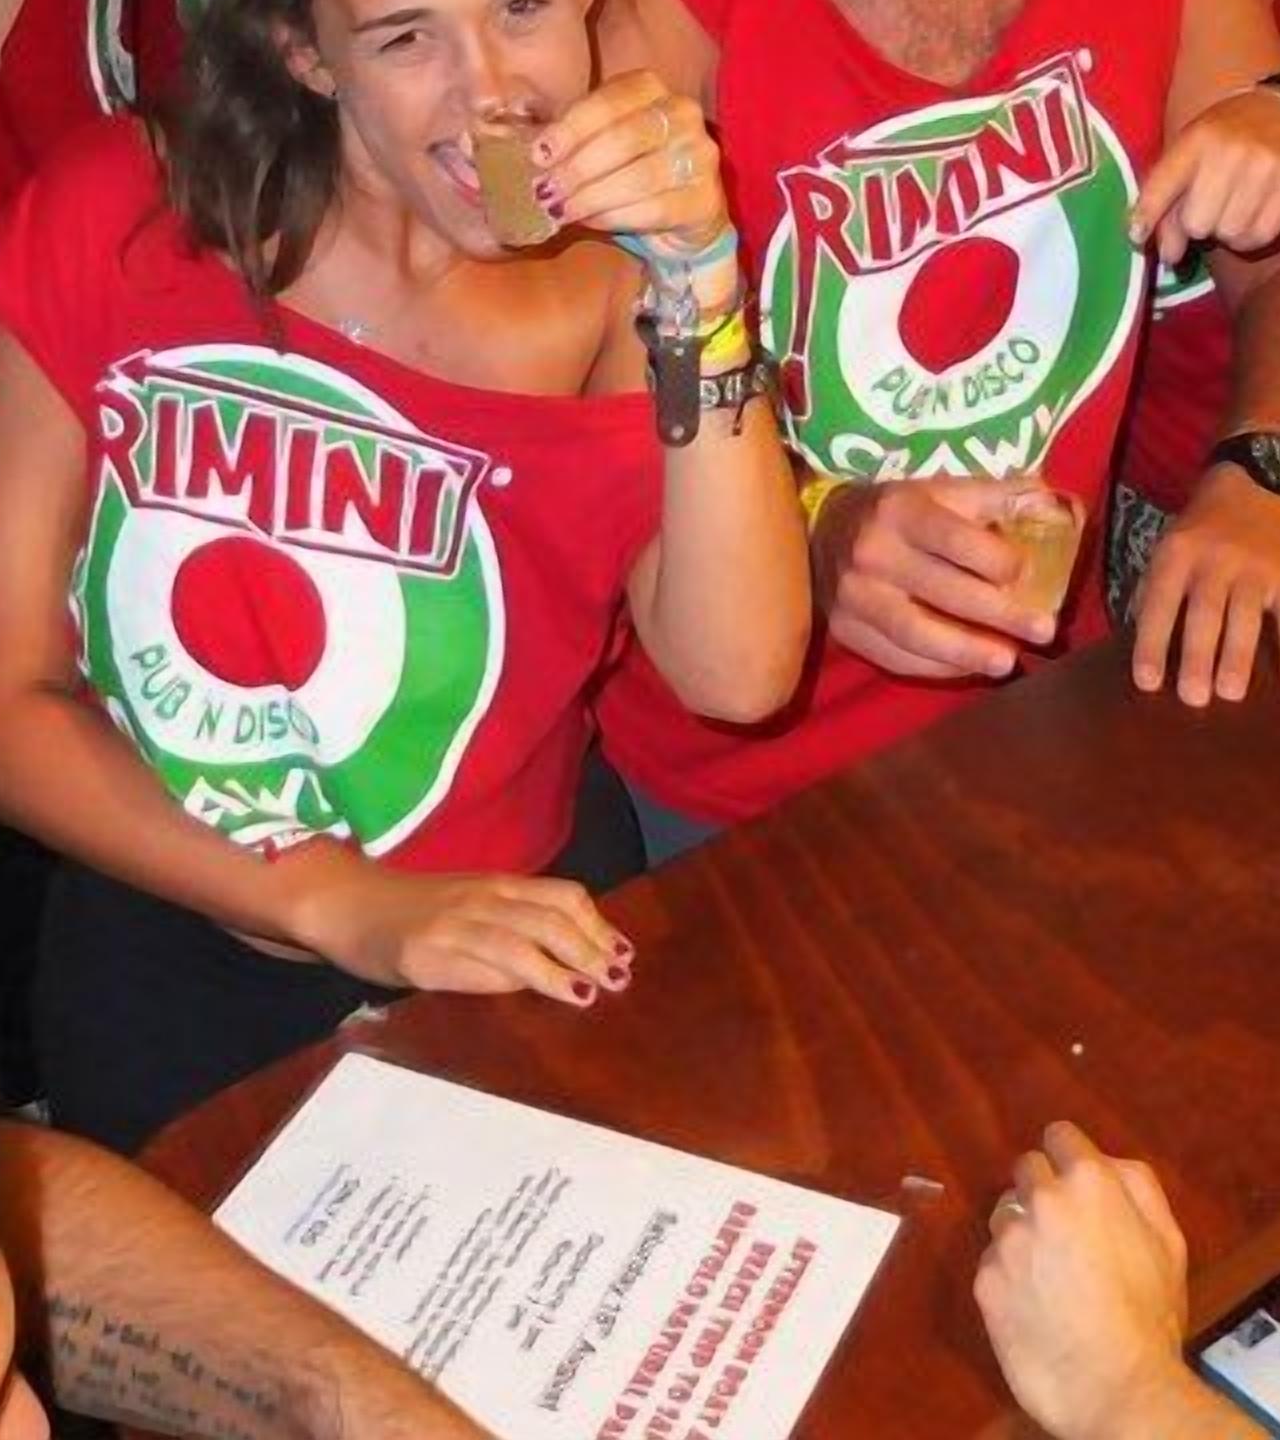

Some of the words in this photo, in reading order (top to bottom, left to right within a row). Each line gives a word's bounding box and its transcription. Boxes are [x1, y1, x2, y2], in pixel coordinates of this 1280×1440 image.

[962, 338, 1042, 408] DISCO
[89, 382, 452, 562] RIMINI
[194, 696, 224, 741] N
[720, 1241, 776, 1313] BEACH
[736, 1238, 818, 1364] AFTERNOON
[666, 1371, 701, 1405] TO
[697, 1364, 749, 1429] BOAT
